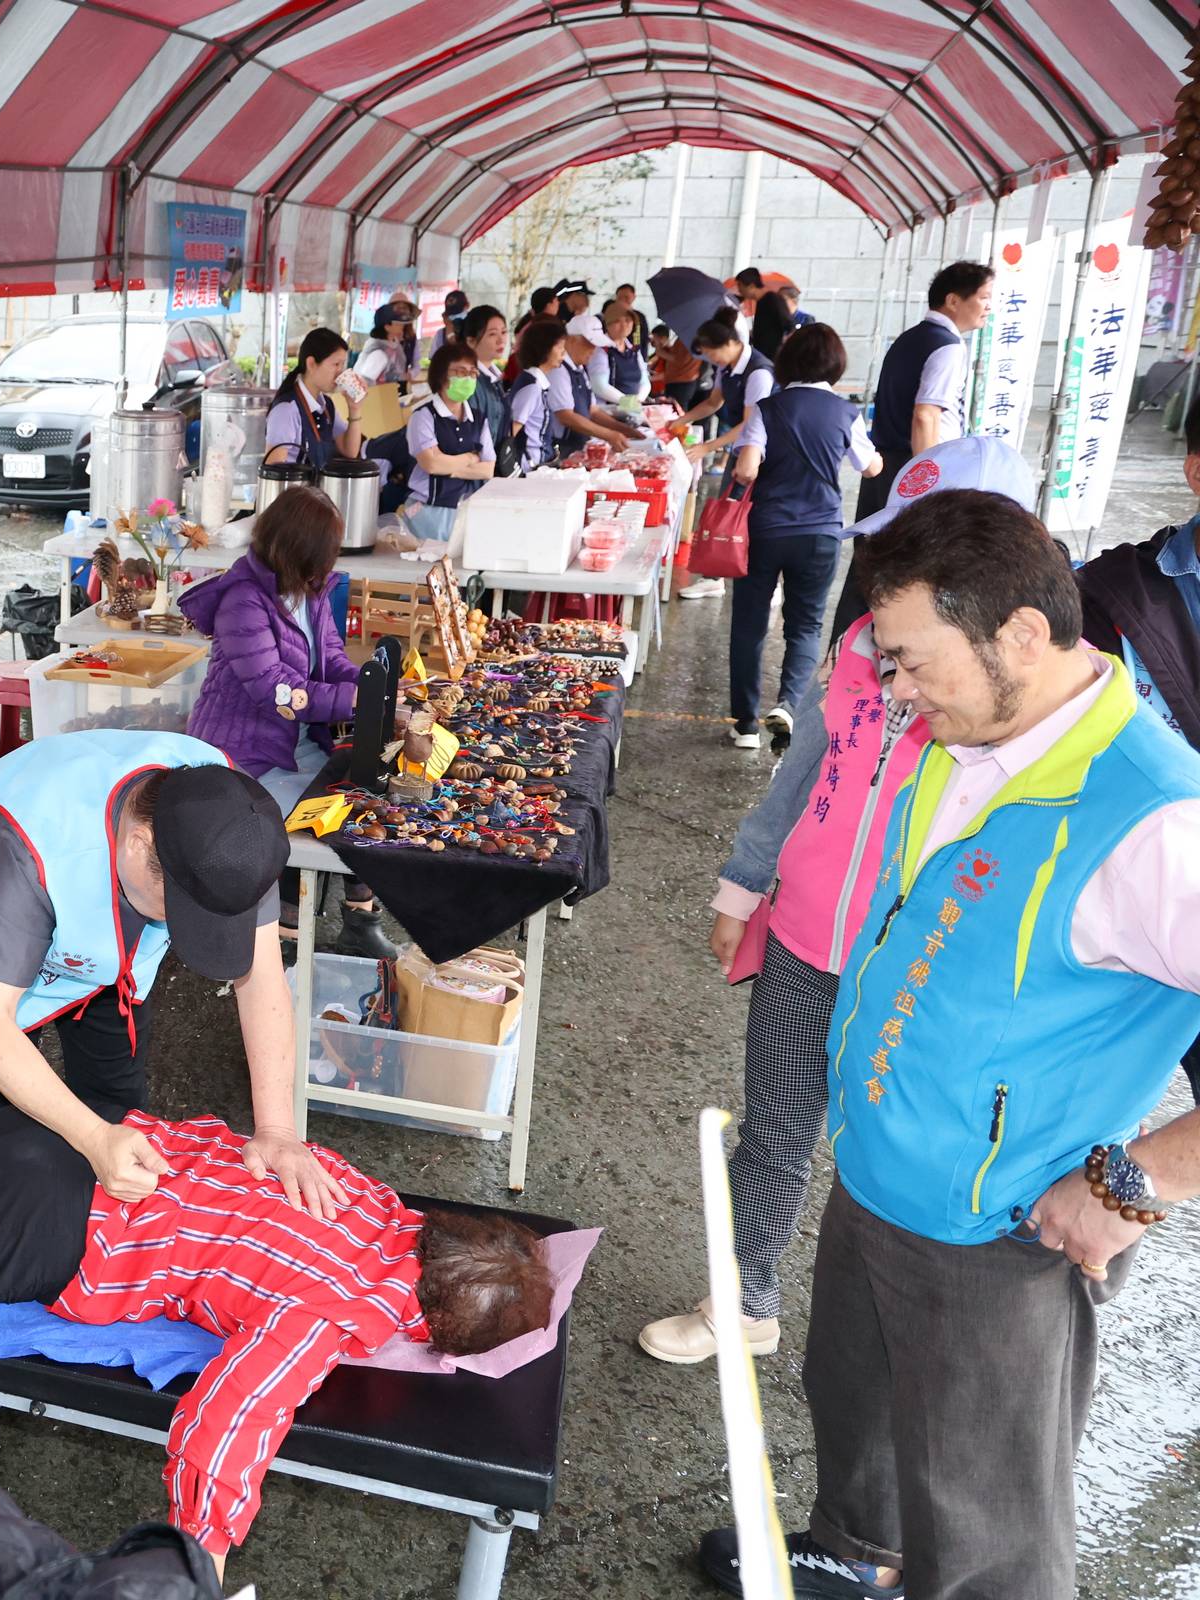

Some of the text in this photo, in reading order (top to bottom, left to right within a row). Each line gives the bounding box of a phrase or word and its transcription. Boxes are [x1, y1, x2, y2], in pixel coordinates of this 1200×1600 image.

[846, 699, 870, 748] 理事長
[864, 896, 963, 1106] 觀音佛祖慈善會
